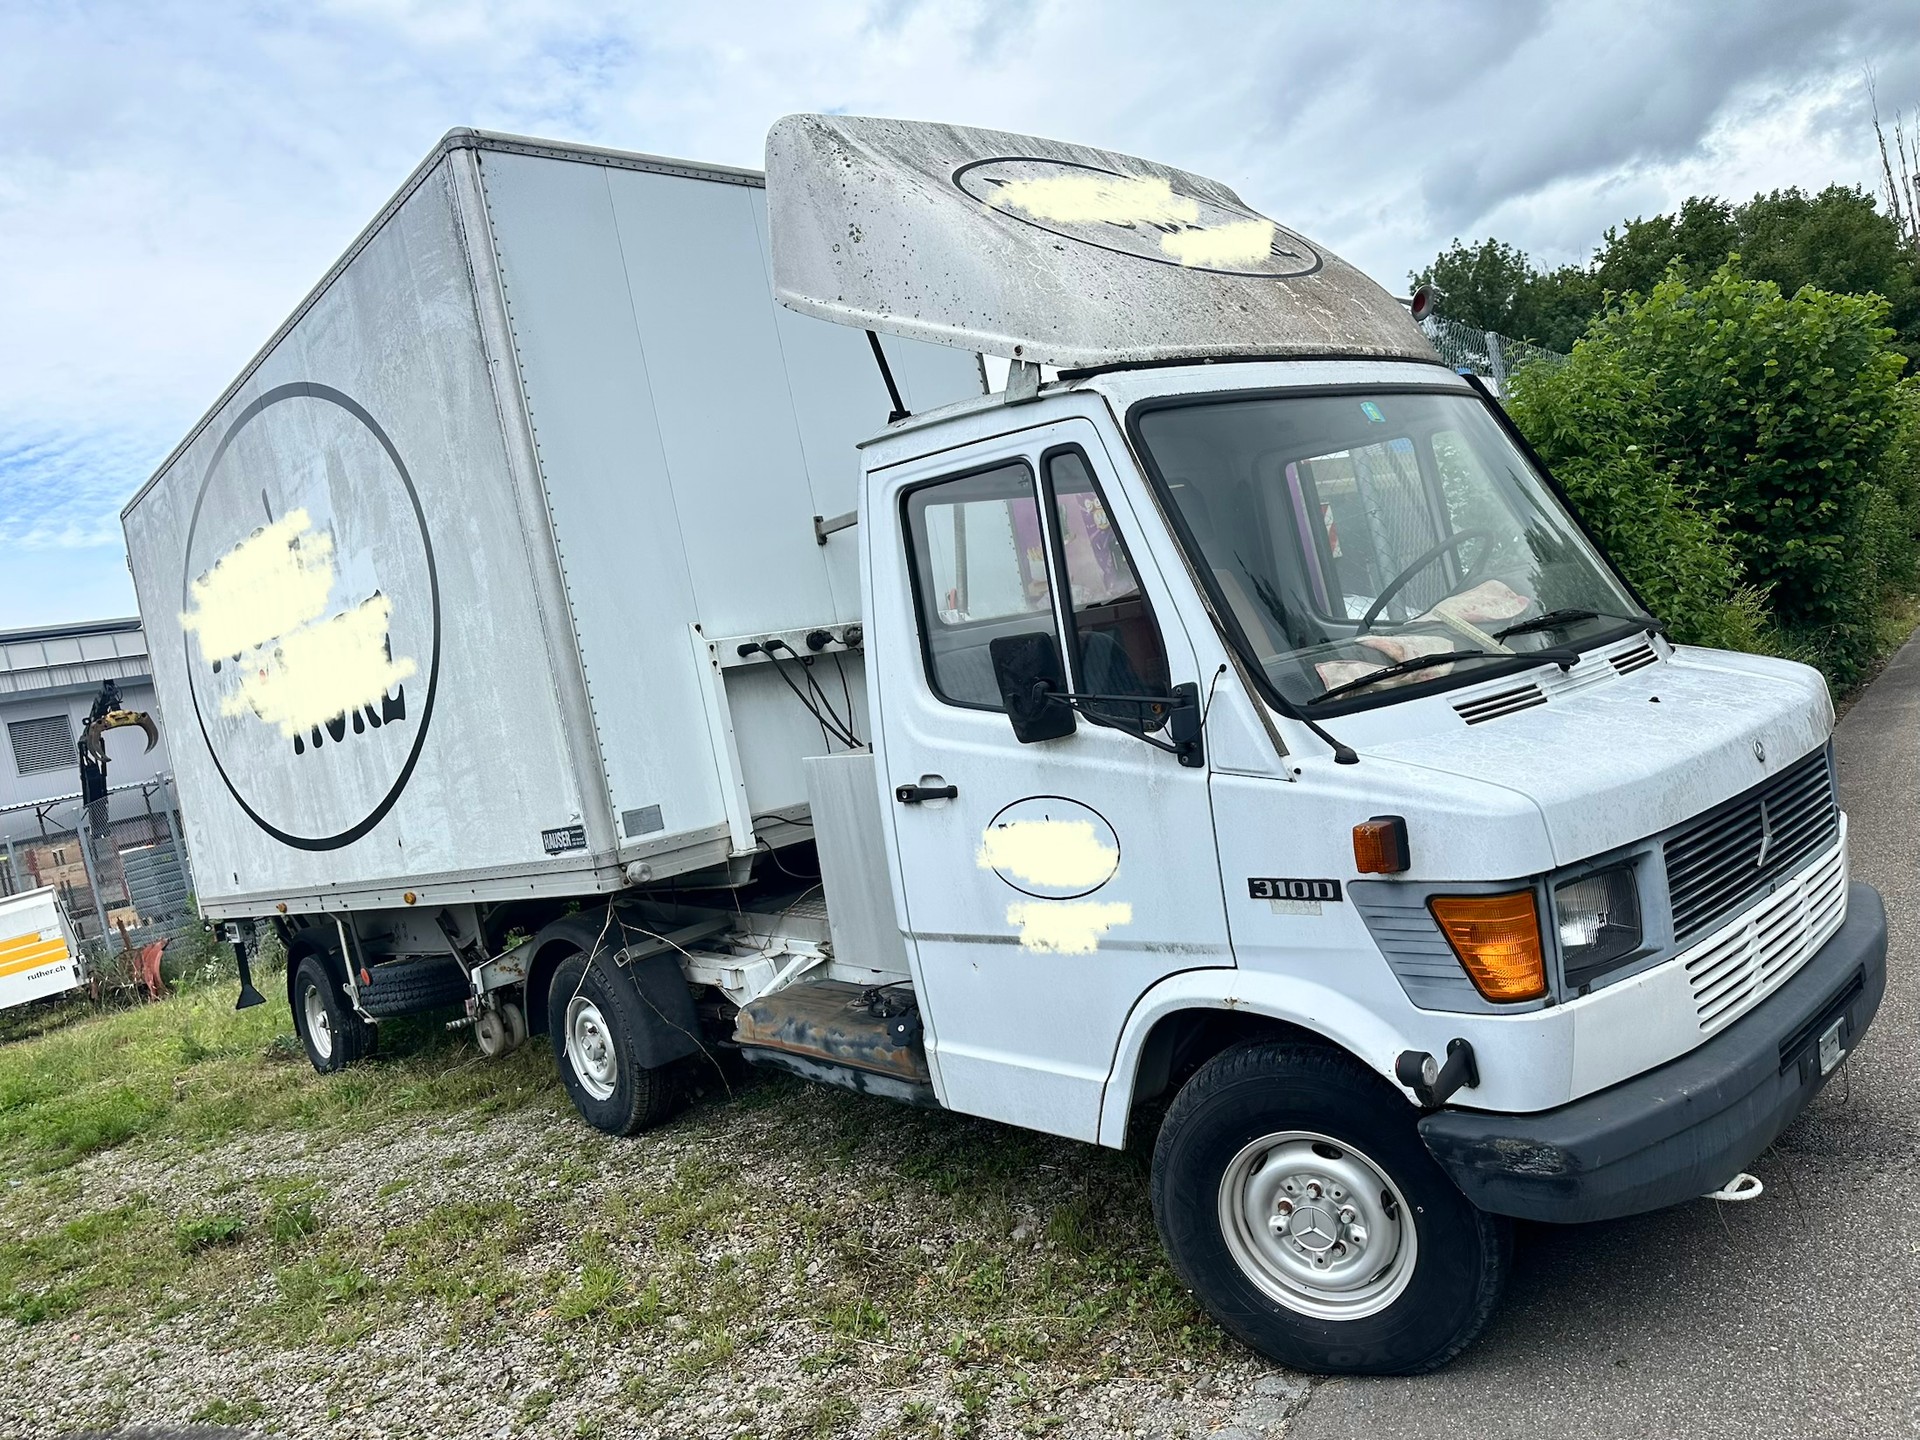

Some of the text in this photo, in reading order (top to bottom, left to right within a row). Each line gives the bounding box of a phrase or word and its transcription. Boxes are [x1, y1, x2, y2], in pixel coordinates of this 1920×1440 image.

[543, 831, 572, 850] HAUSER
[1253, 880, 1334, 899] 310D
[27, 965, 66, 981] ruther.ch
